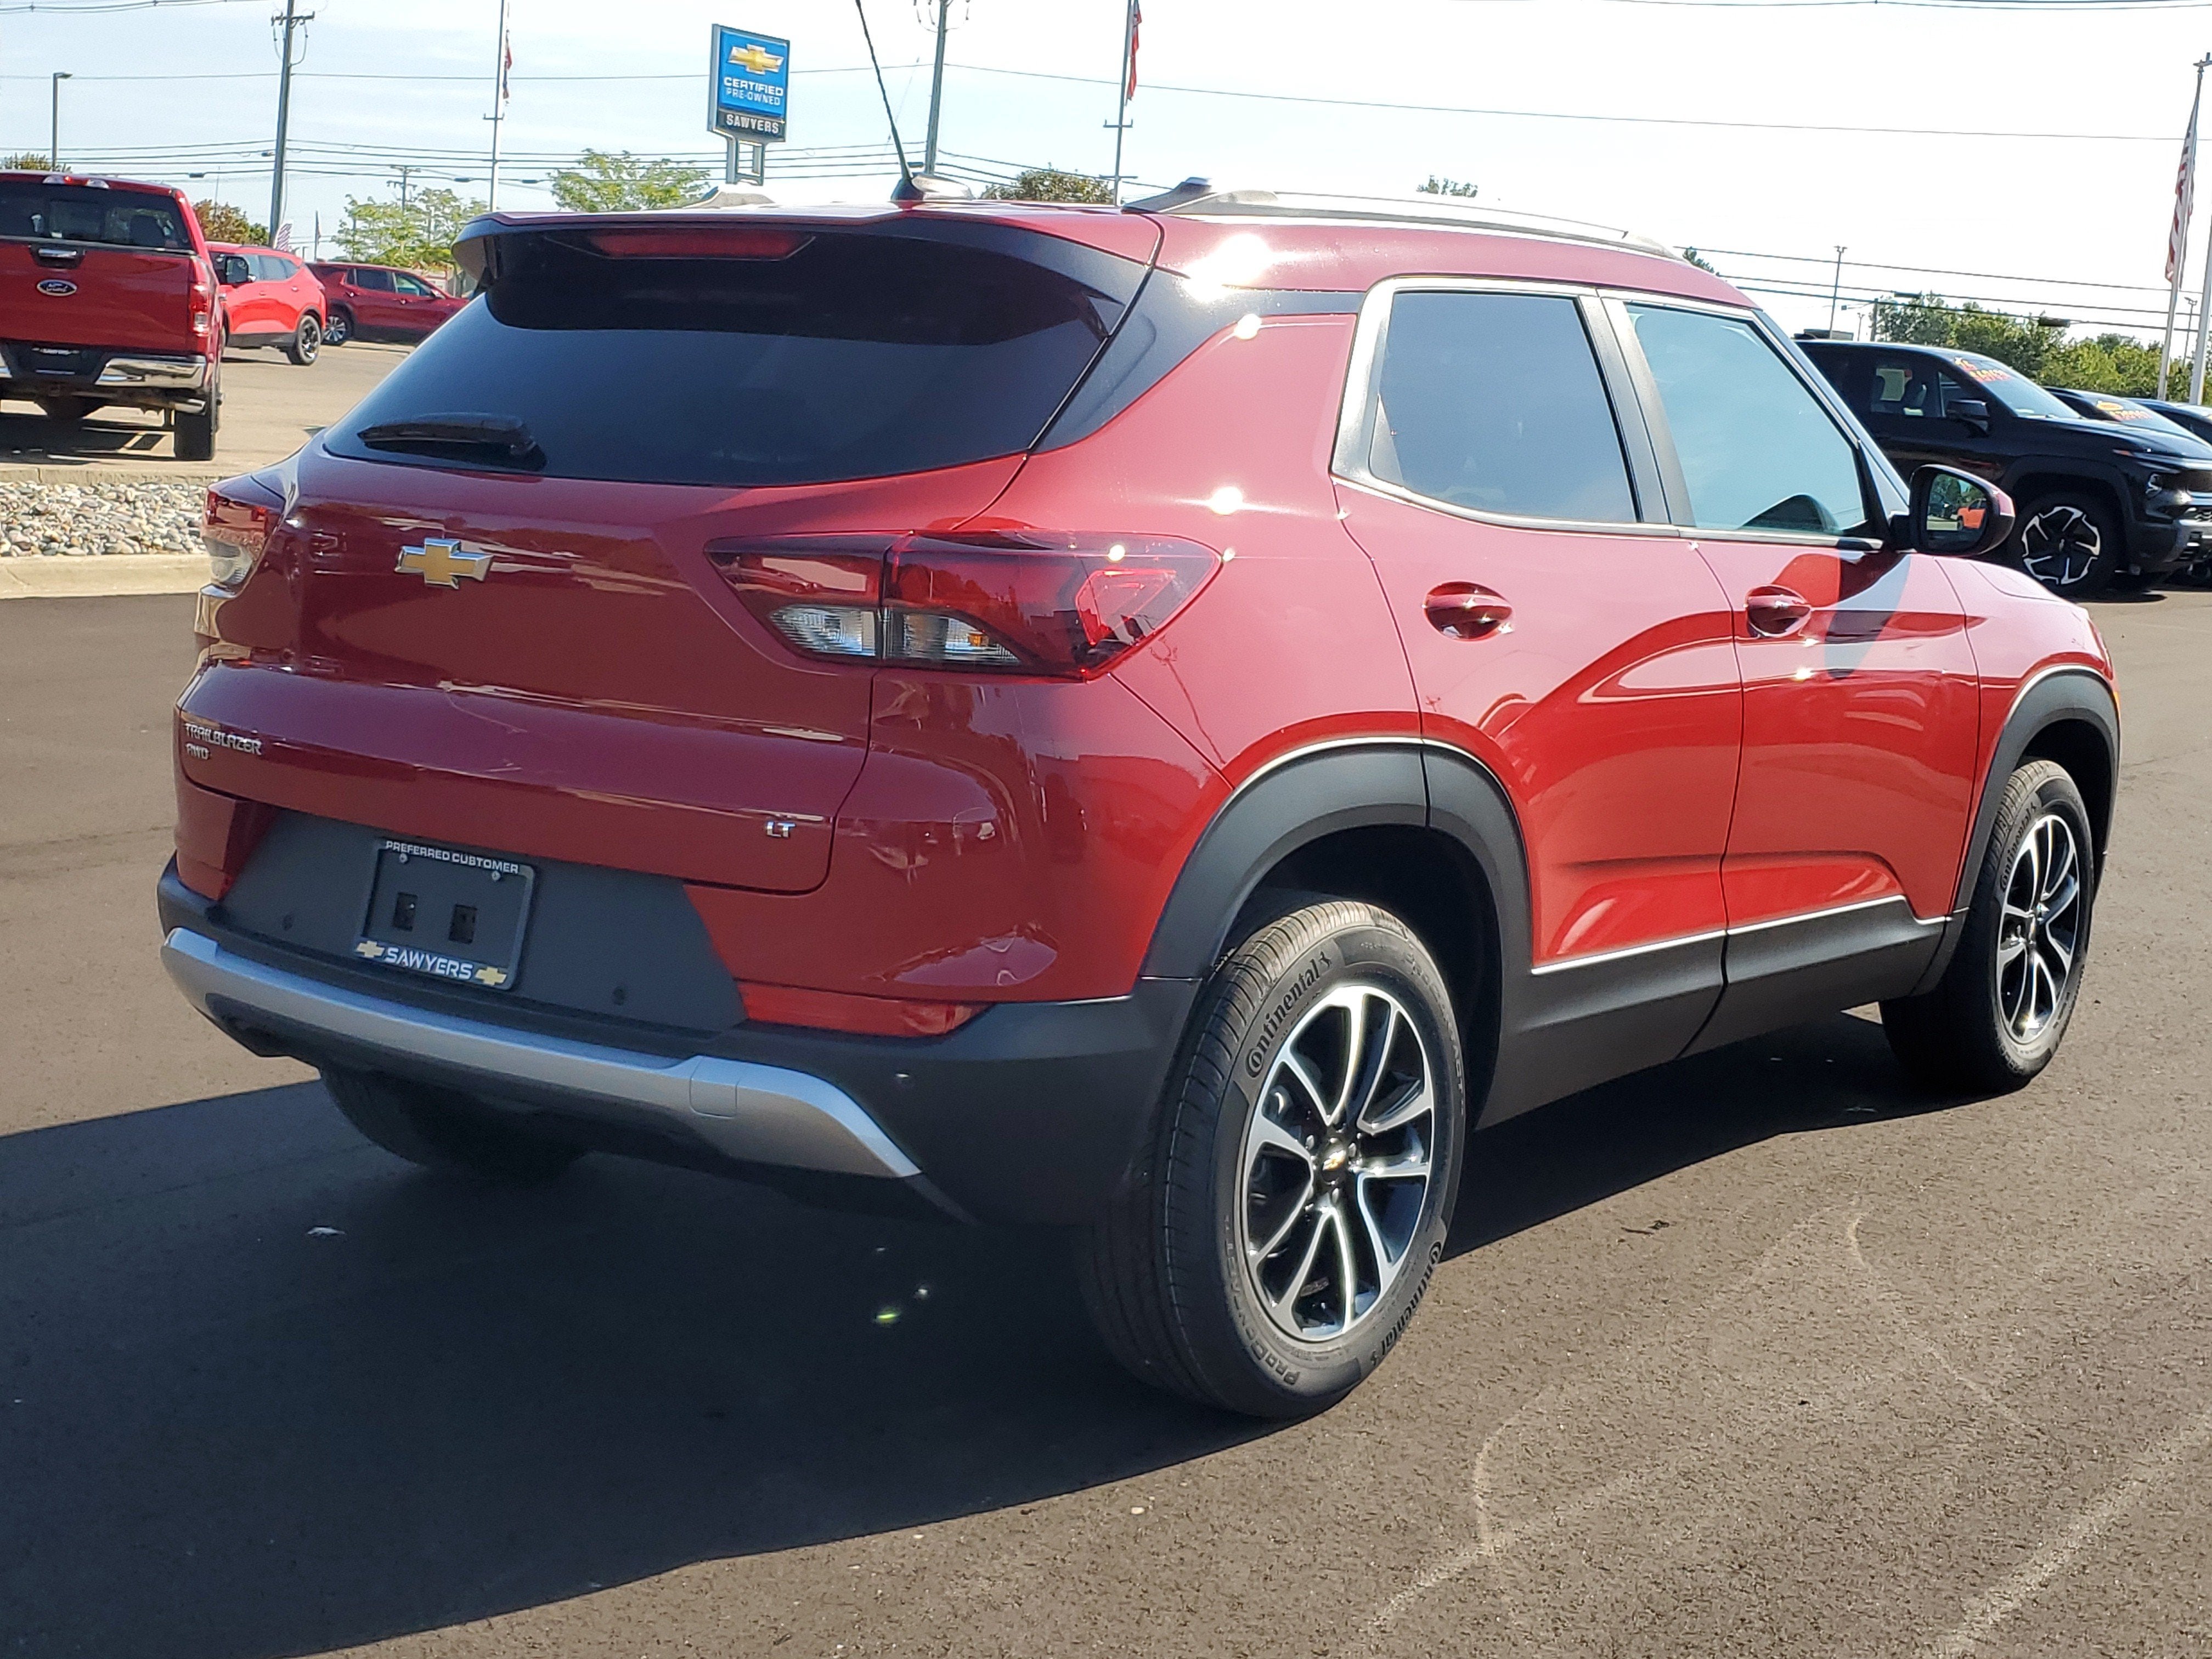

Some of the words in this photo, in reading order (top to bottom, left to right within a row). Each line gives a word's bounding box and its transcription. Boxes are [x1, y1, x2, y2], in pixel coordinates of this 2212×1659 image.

[724, 76, 783, 97] CERTIFIED
[726, 88, 781, 105] PRE-OWNED
[726, 114, 779, 134] SAWYERS
[185, 723, 262, 755] TRAILBLAZER
[186, 743, 209, 760] AWD
[767, 822, 795, 838] LT
[386, 840, 450, 861] PREFERRED
[452, 853, 520, 874] CUSTOMER
[385, 947, 473, 980] SAWYERS
[1245, 959, 1320, 1078] Continental
